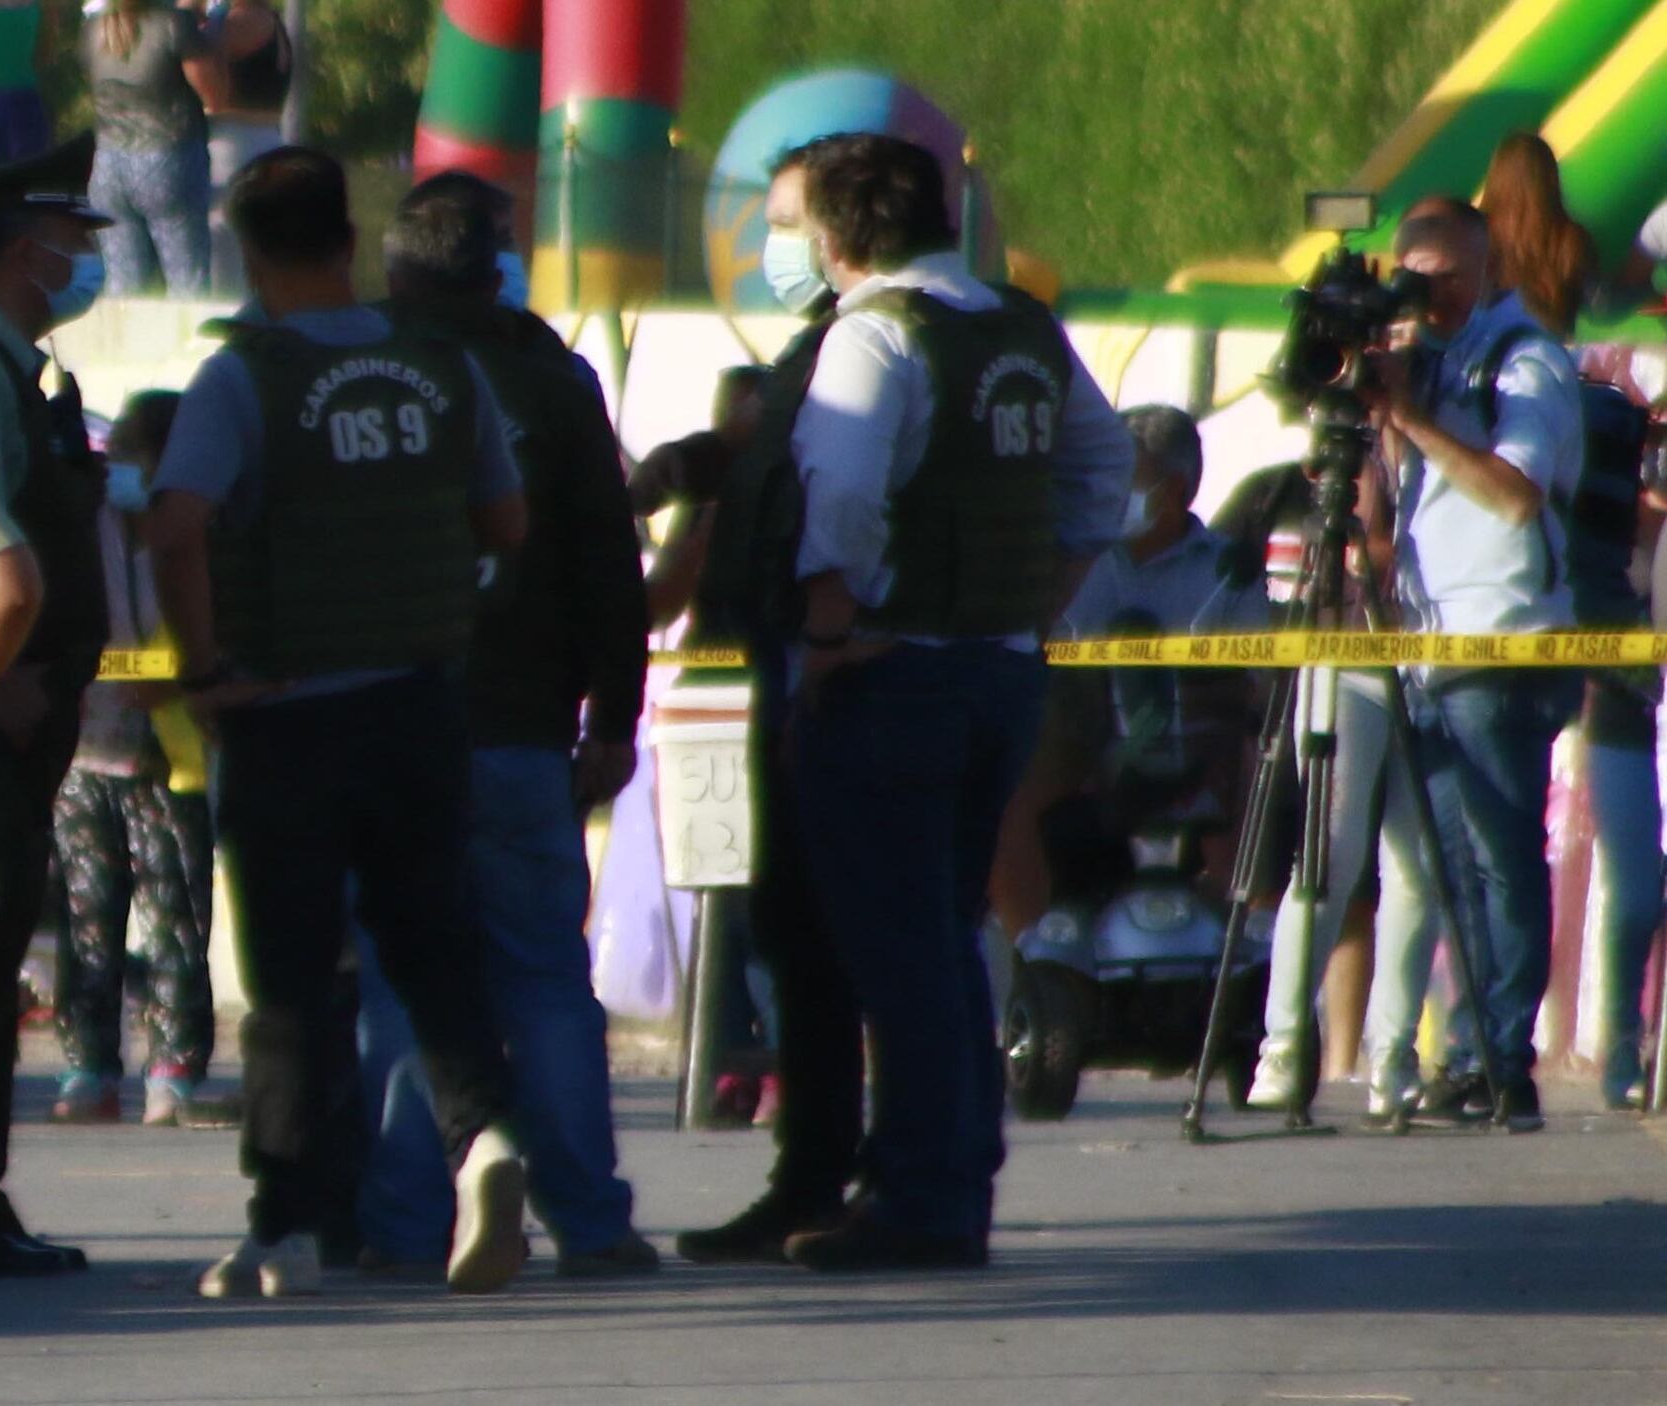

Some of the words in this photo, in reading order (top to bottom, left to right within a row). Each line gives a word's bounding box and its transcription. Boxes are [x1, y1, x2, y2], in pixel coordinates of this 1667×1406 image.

[299, 358, 450, 430] CARABINEROS
[397, 403, 428, 455] 9
[1034, 401, 1051, 453] 9
[1089, 642, 1109, 660] DE
[1118, 641, 1163, 661] CHILE
[1188, 639, 1212, 660] NO
[1218, 637, 1275, 661] PASAR
[1304, 634, 1424, 662] CARABINEROS
[1433, 636, 1454, 661] DE
[1462, 636, 1509, 662] CHILE
[1534, 637, 1556, 662] NO
[1566, 636, 1621, 662] PASAR
